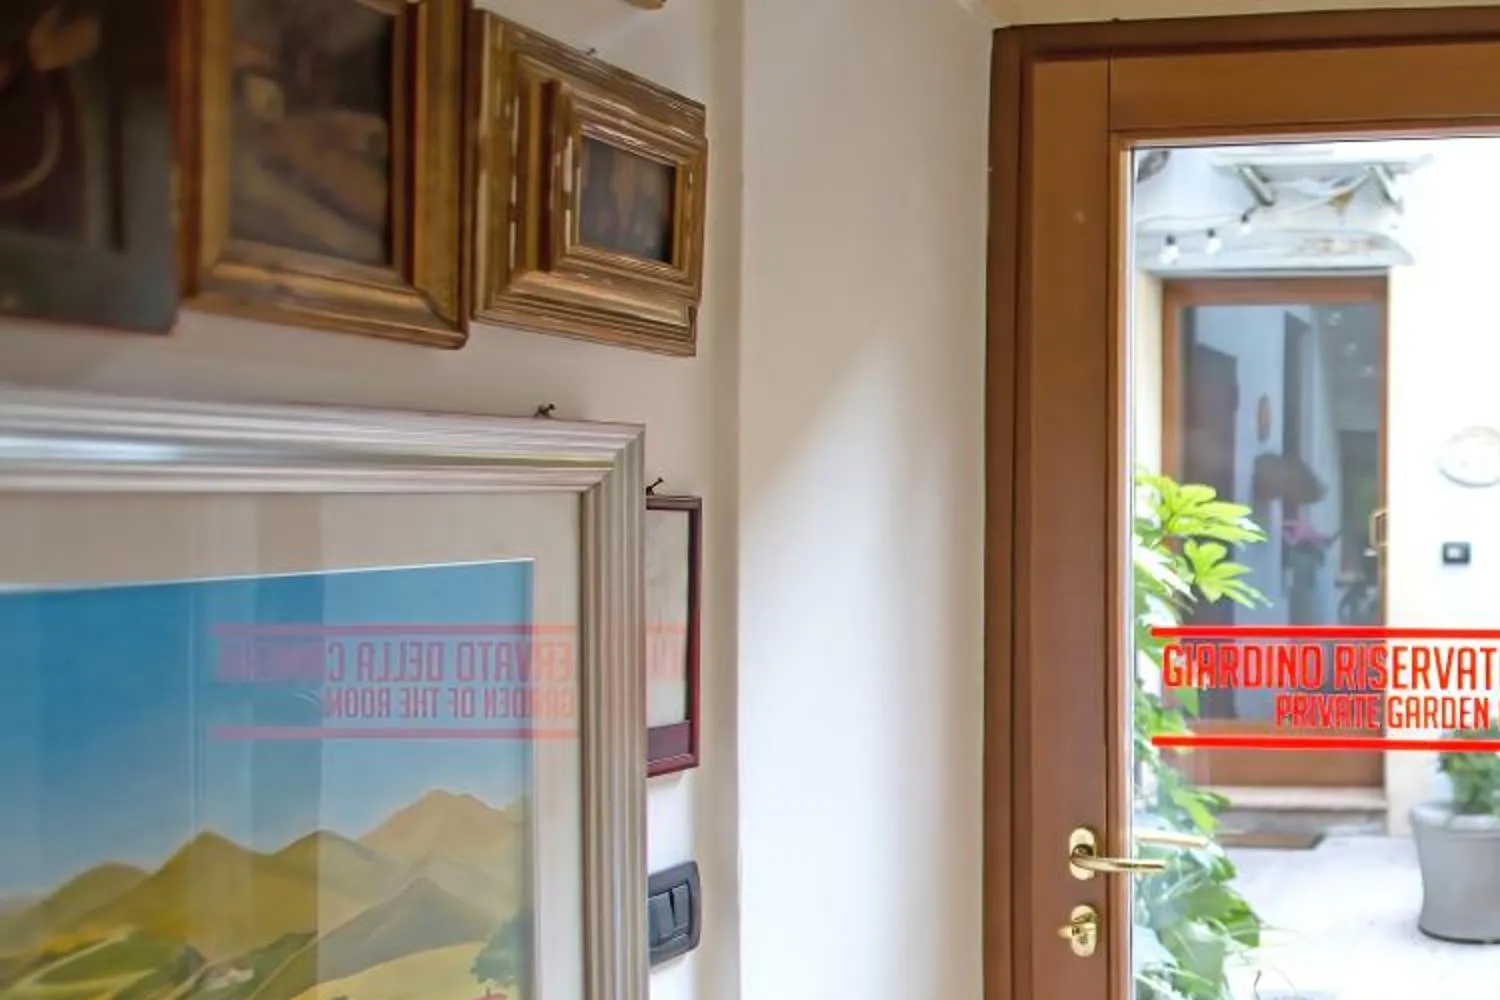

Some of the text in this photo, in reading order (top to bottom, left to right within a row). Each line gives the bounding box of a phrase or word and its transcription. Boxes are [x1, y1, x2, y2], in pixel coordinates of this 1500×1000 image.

[1162, 643, 1322, 690] GIARDINO
[1275, 692, 1381, 729] PRIVATE
[1386, 695, 1491, 730] GARDEN
